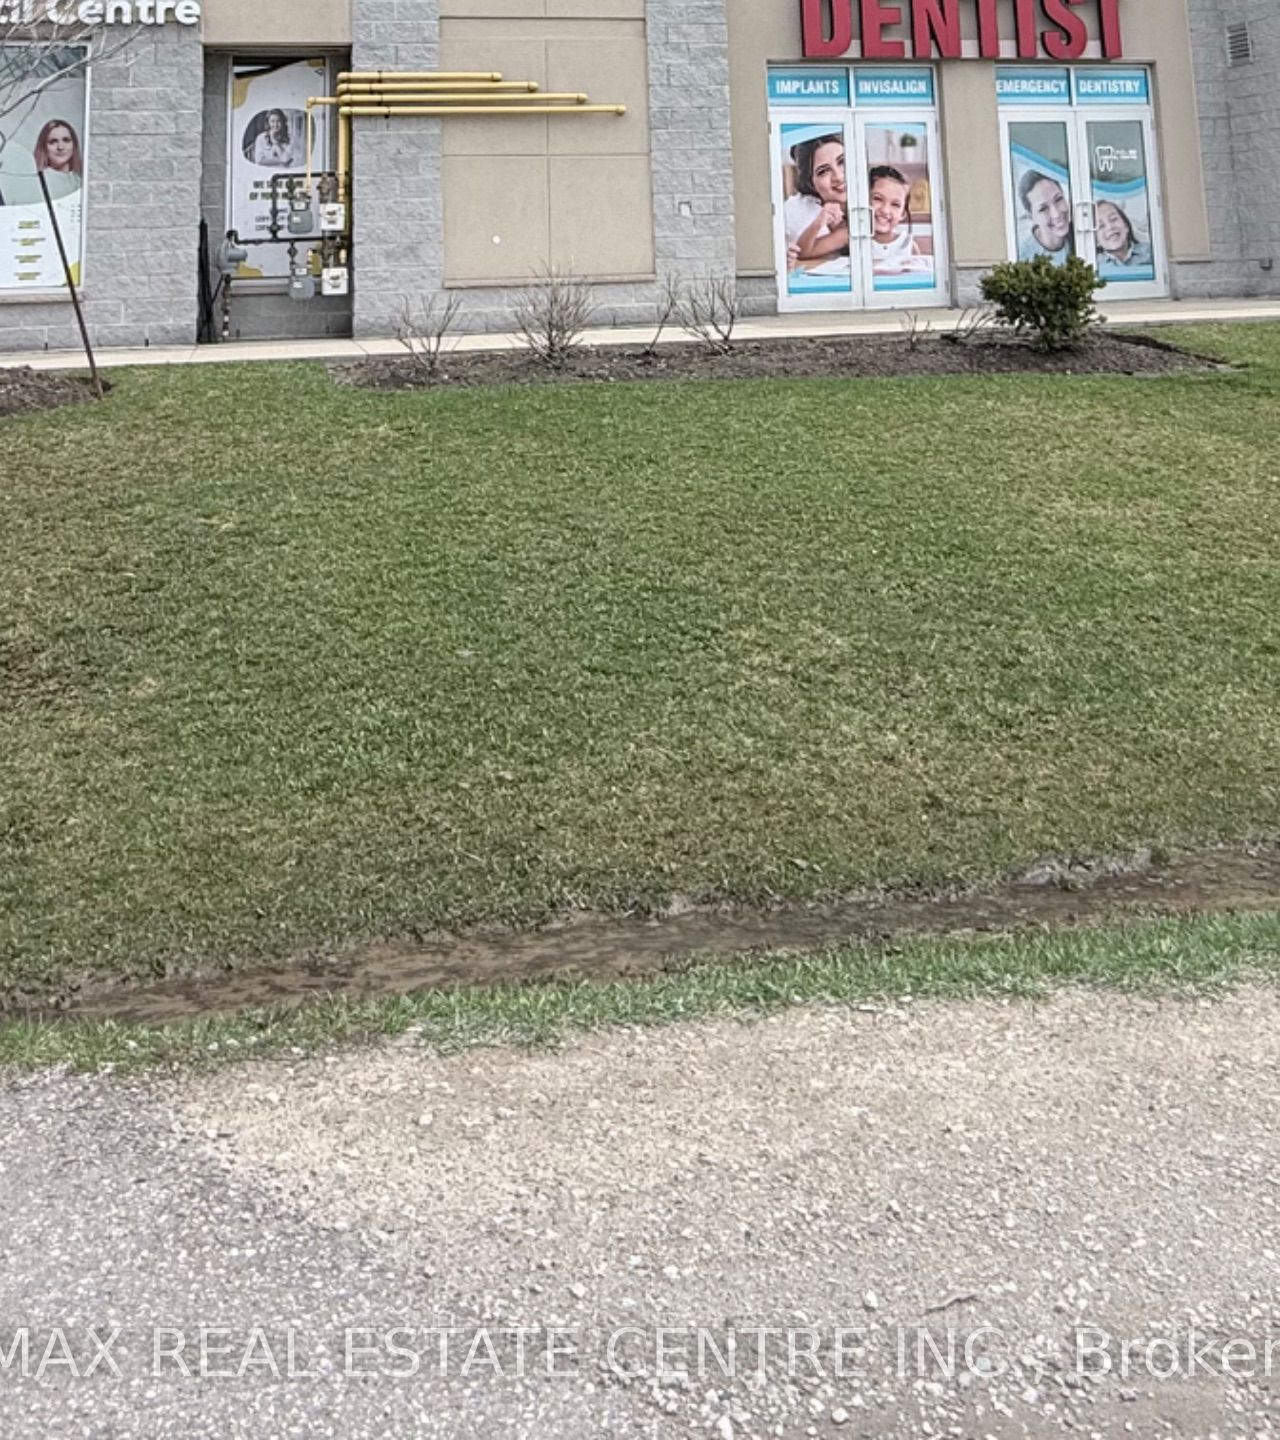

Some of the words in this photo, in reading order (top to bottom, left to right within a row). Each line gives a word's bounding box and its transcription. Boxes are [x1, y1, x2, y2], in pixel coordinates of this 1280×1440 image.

[775, 78, 840, 95] IMPLANTS
[858, 78, 927, 95] INVISALIGN
[996, 78, 1067, 94] EMERGENCY
[1079, 78, 1141, 94] DENTISTRY
